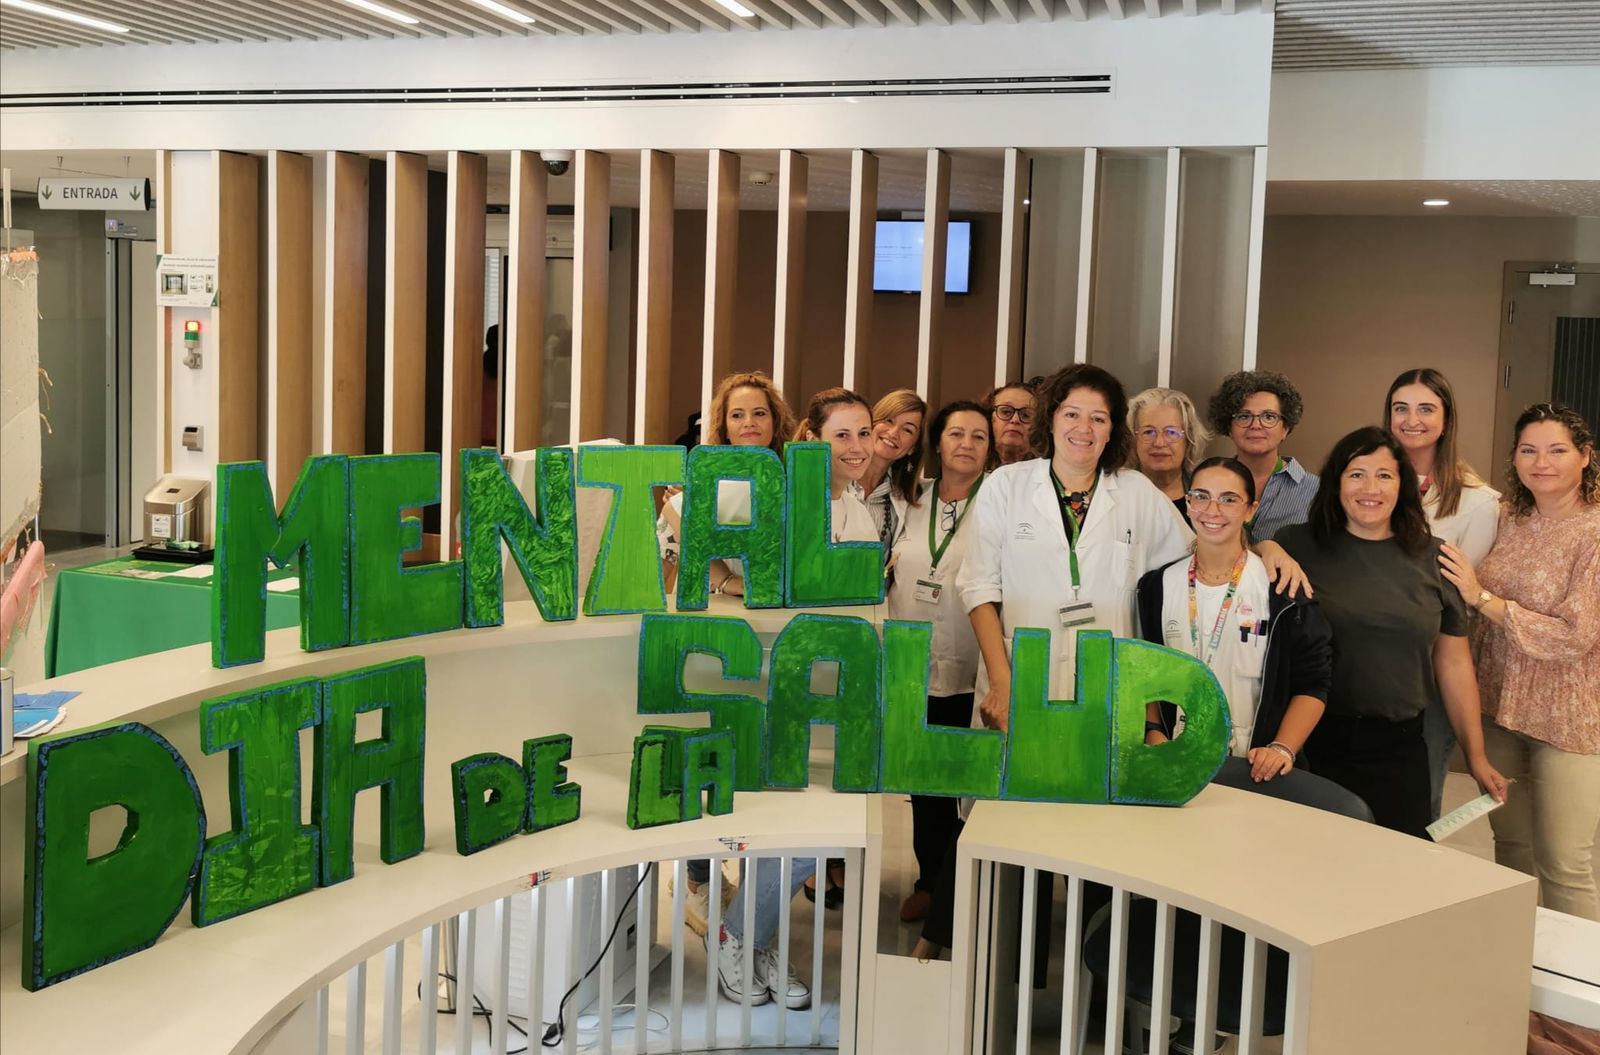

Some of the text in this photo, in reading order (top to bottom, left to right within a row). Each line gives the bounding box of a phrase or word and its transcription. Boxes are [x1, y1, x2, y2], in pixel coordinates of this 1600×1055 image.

[63, 187, 118, 199] ENTRADA
[212, 441, 885, 669] MENTAL
[22, 612, 1232, 993] DIA DE LA SALUD
